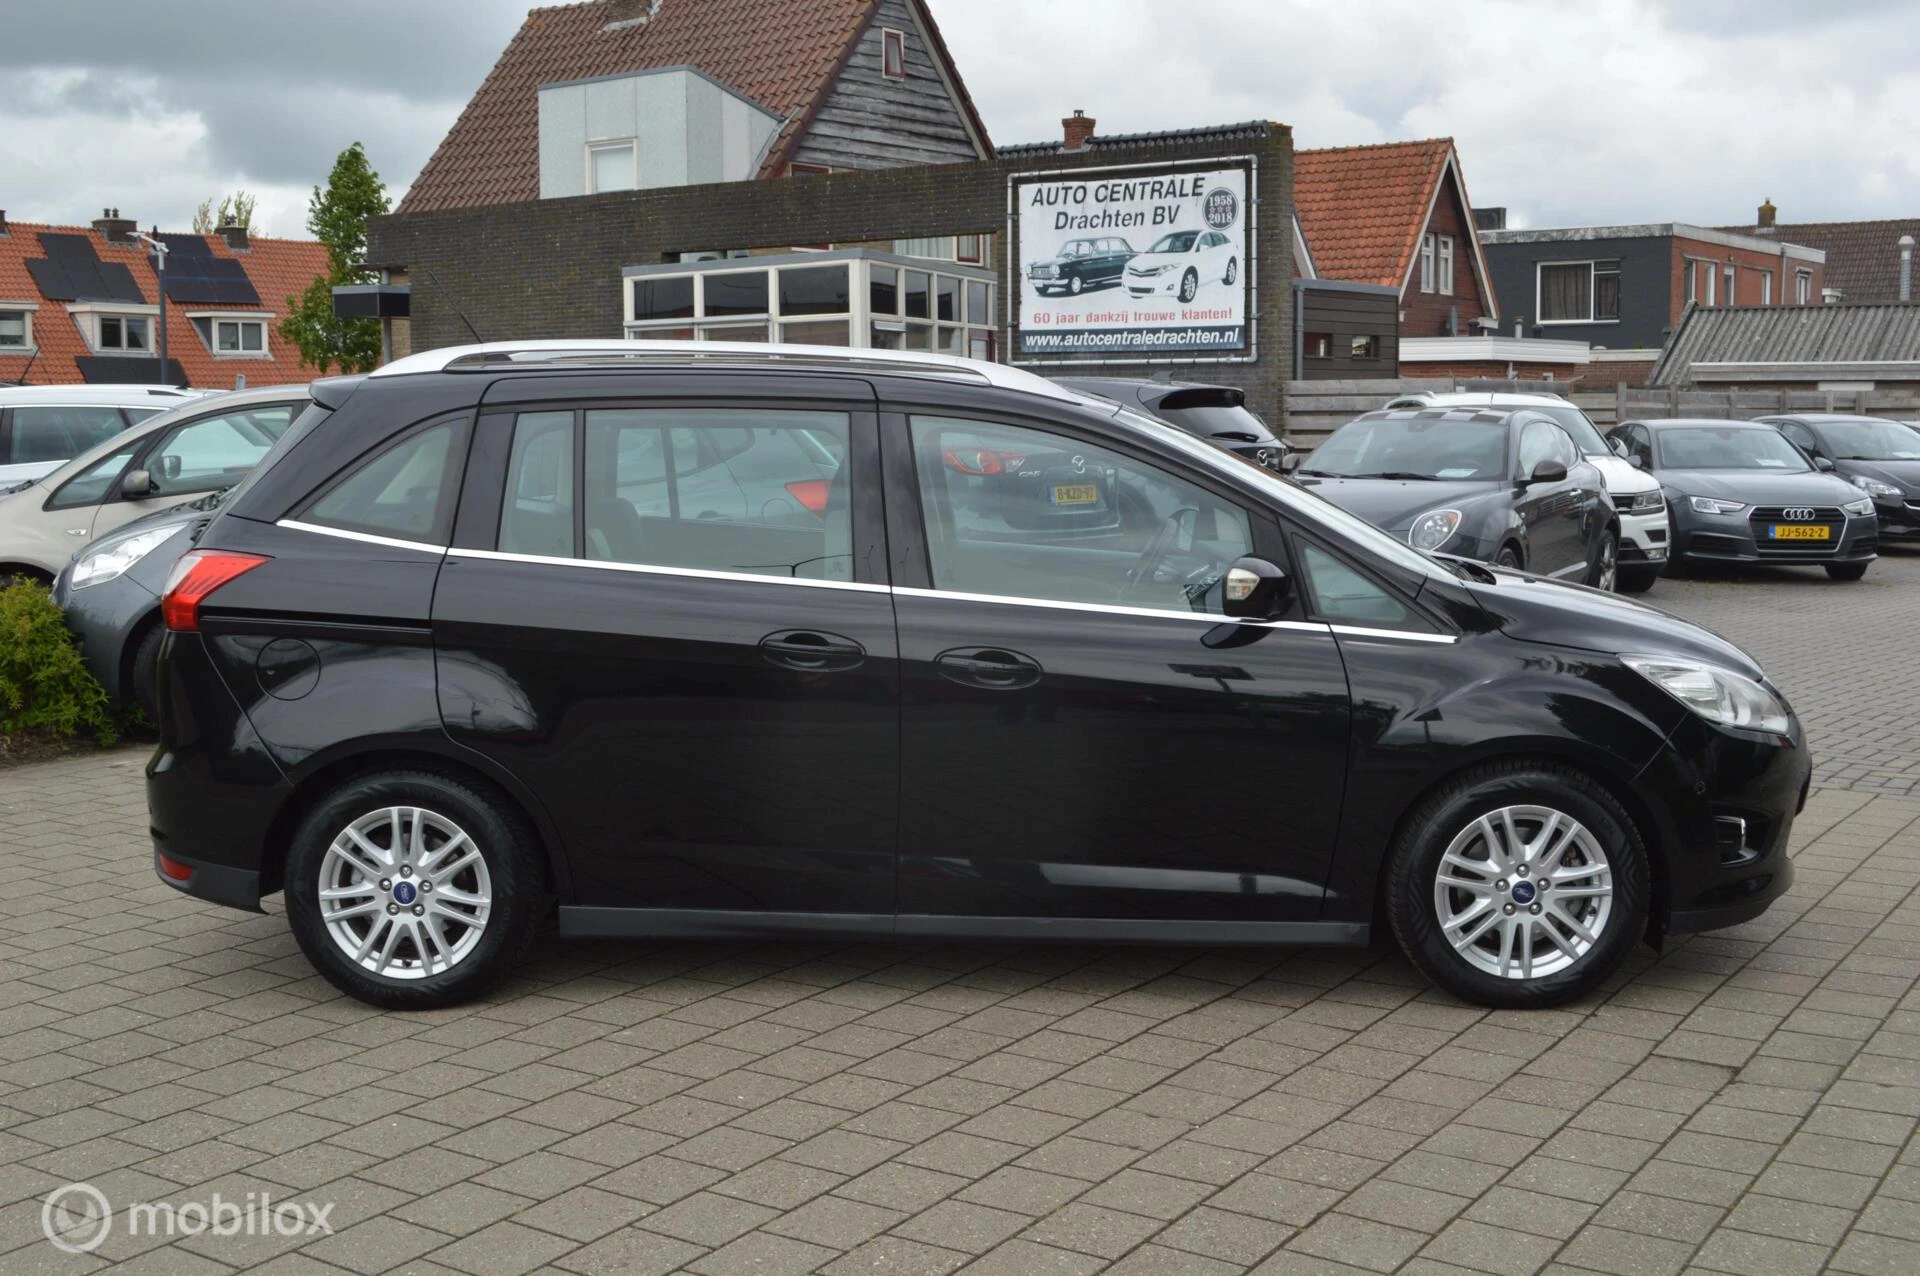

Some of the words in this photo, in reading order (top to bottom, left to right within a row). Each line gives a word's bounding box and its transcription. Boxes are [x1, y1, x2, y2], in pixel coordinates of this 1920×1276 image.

[1031, 186, 1087, 206] AUTO
[1094, 177, 1205, 203] CENTRALE
[1209, 195, 1232, 206] 1958
[1054, 209, 1145, 230] Drachten
[1152, 204, 1180, 225] BV
[1209, 212, 1232, 224] 2018
[1033, 312, 1050, 324] 60
[1056, 312, 1080, 325] jaar
[1086, 310, 1128, 324] dankzij
[1134, 310, 1176, 322] trouwe
[1181, 307, 1233, 321] klanten!
[1025, 327, 1239, 347] www.autocentraledrachten.nl
